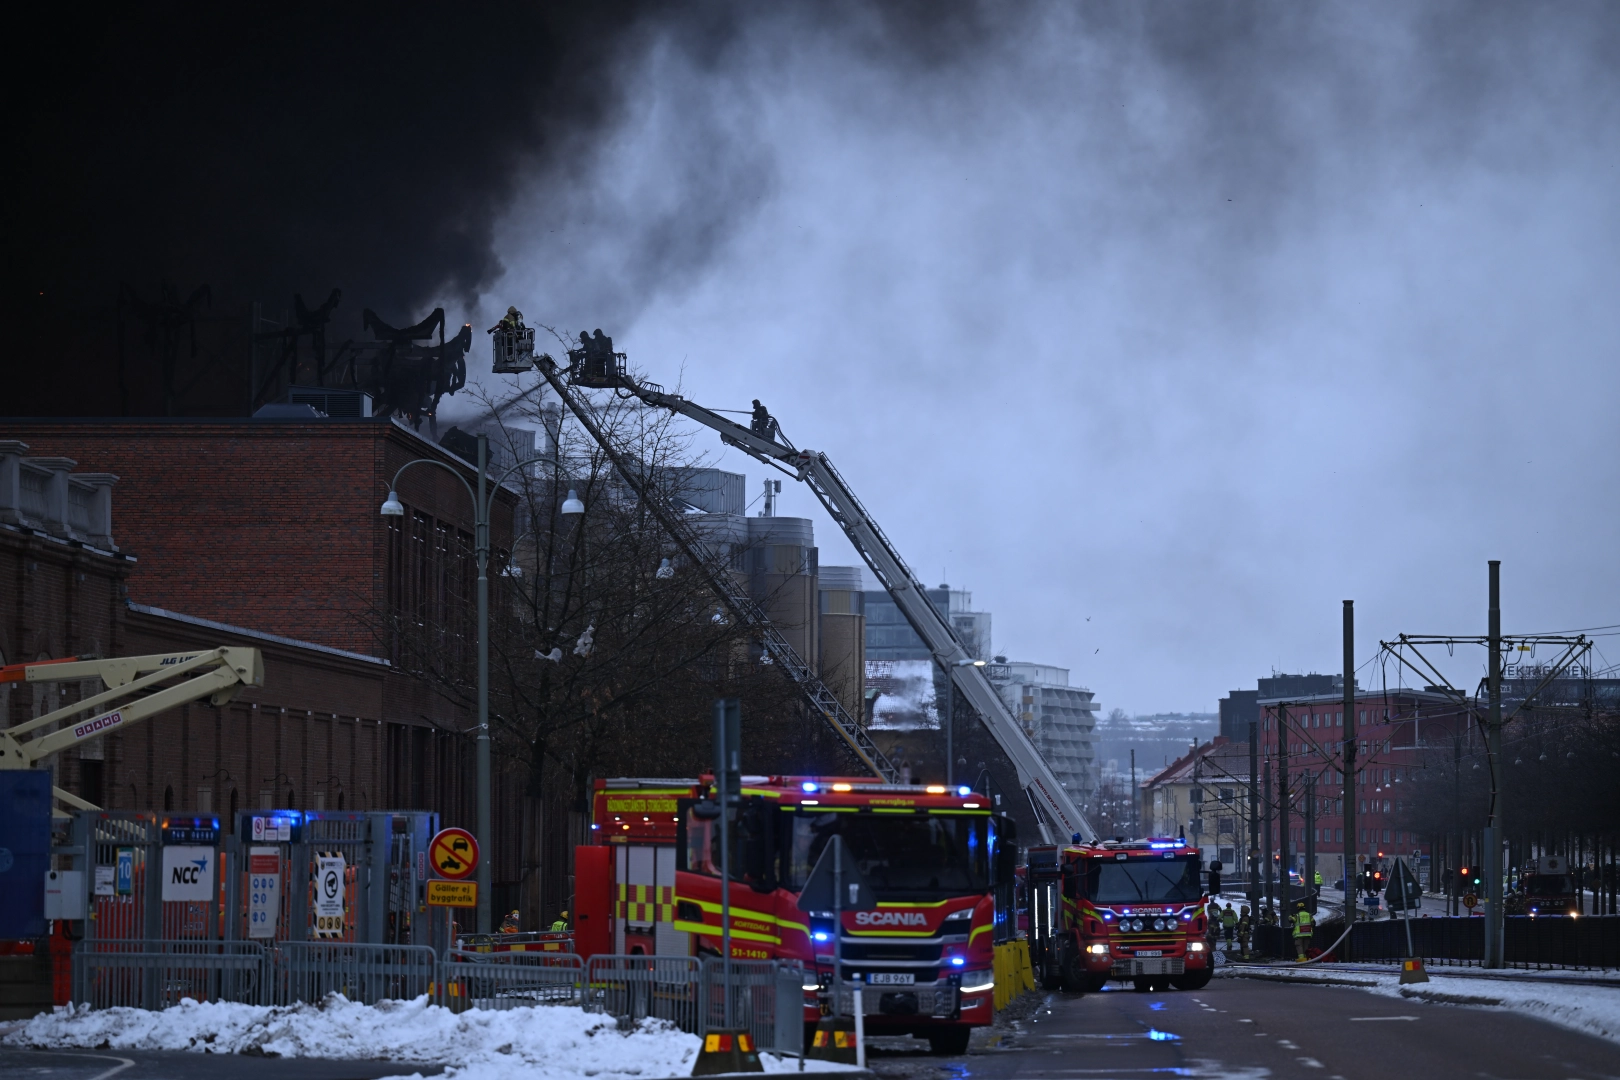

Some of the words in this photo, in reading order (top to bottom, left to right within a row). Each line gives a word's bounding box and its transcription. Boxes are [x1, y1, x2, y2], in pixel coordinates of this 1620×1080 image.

[160, 657, 177, 665] JLG
[76, 714, 120, 736] CRAMO
[120, 861, 131, 879] 10
[172, 867, 199, 884] NCC
[462, 885, 470, 894] ej
[431, 894, 473, 903] byggtrafik
[1370, 908, 1378, 916] 30
[855, 911, 928, 926] SCANIA
[733, 920, 770, 932] KORTEDALA
[731, 947, 768, 959] 51-1410
[873, 973, 891, 983] EJB
[893, 973, 910, 983] 96Y
